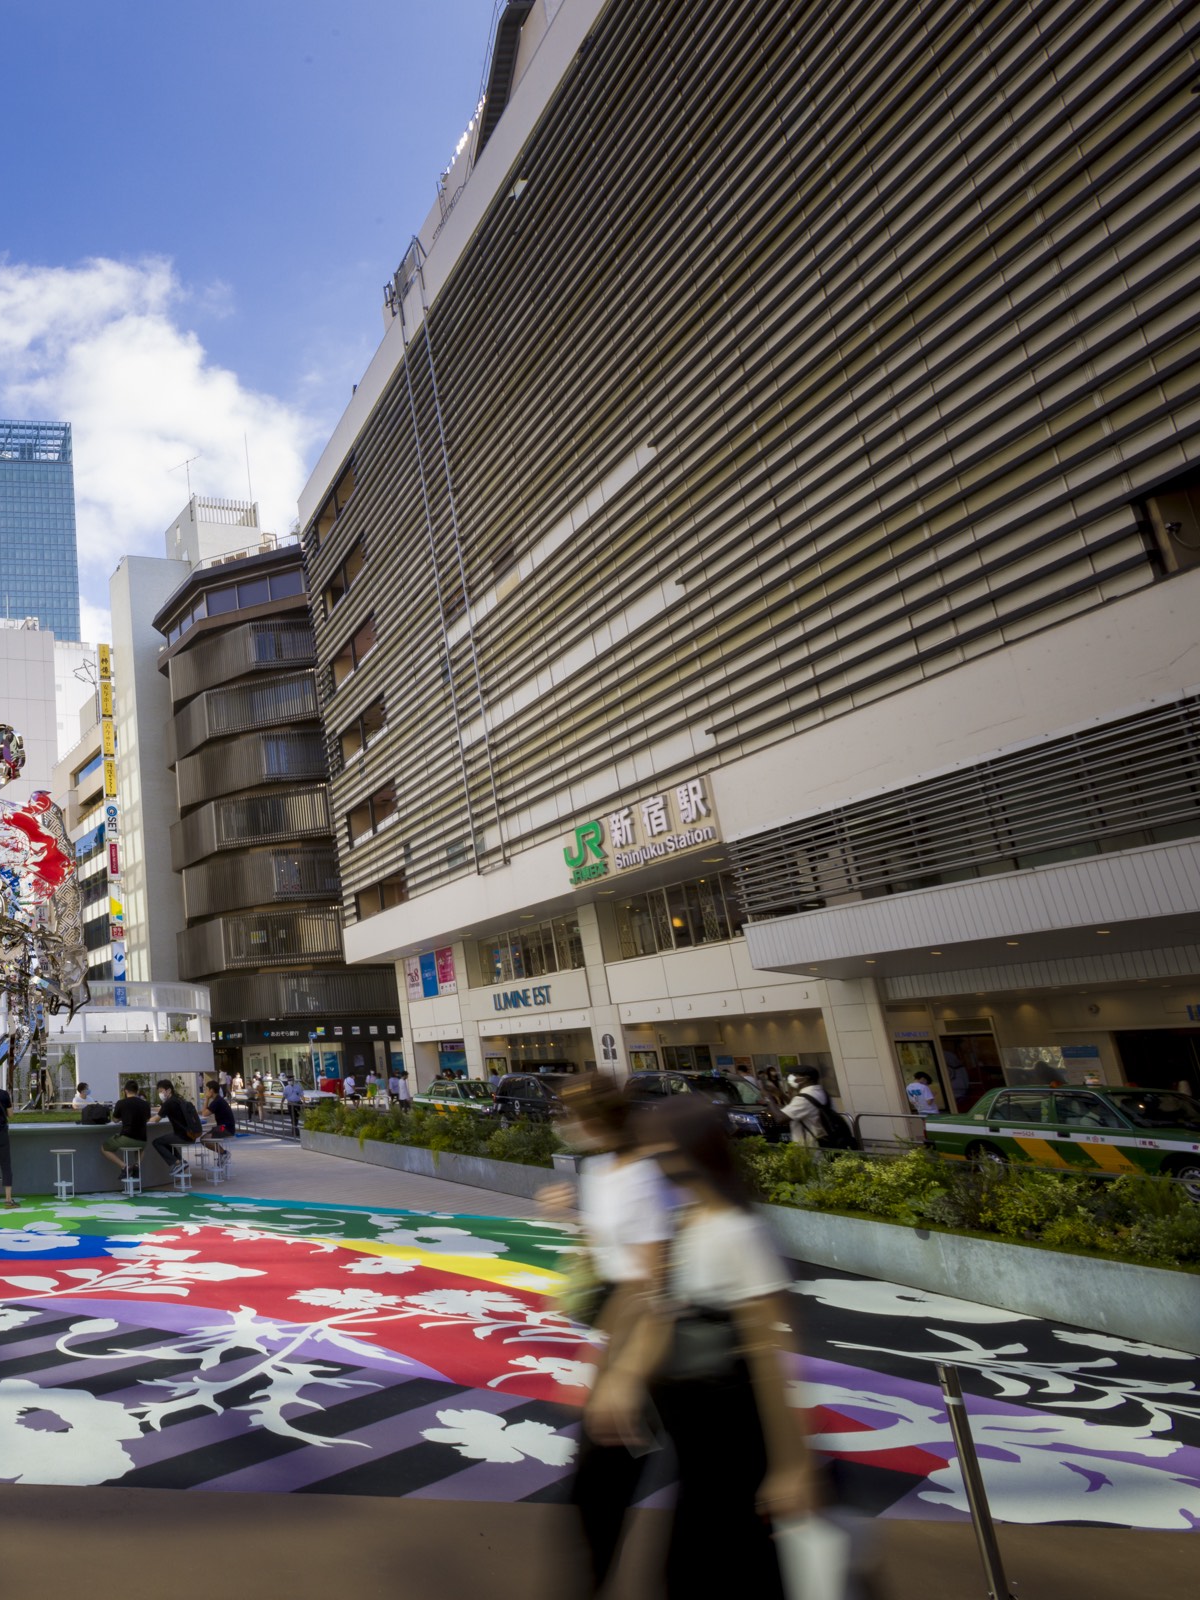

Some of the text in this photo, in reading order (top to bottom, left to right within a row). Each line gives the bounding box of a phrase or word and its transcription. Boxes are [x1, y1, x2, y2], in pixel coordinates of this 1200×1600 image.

[609, 777, 712, 850] 新宿駅
[563, 820, 606, 868] JR
[615, 825, 714, 870] Shinjuku Station
[569, 861, 610, 885] JR東日本
[493, 984, 552, 1011] LUMINE EST
